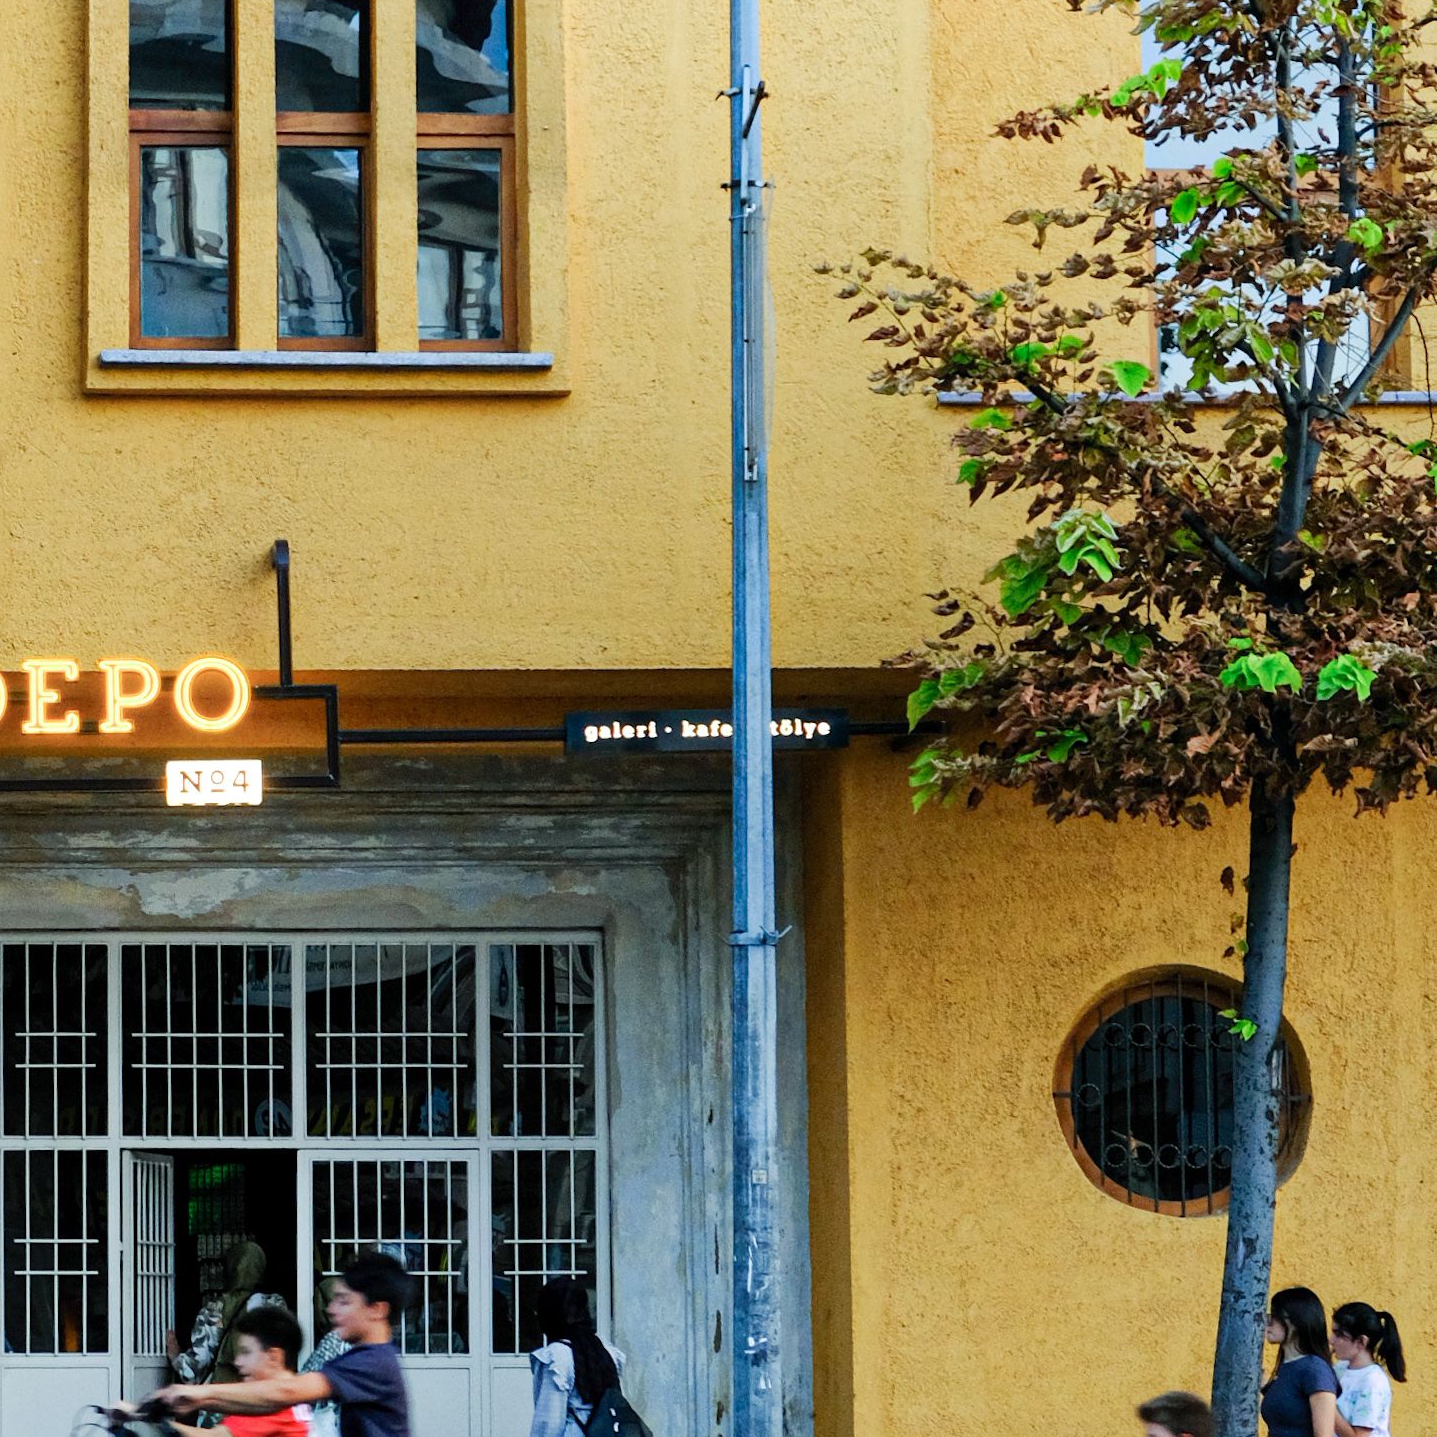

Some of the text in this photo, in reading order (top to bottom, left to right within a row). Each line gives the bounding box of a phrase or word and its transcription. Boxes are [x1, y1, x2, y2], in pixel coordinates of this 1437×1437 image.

[584, 718, 831, 742] galeri kafe tölye
